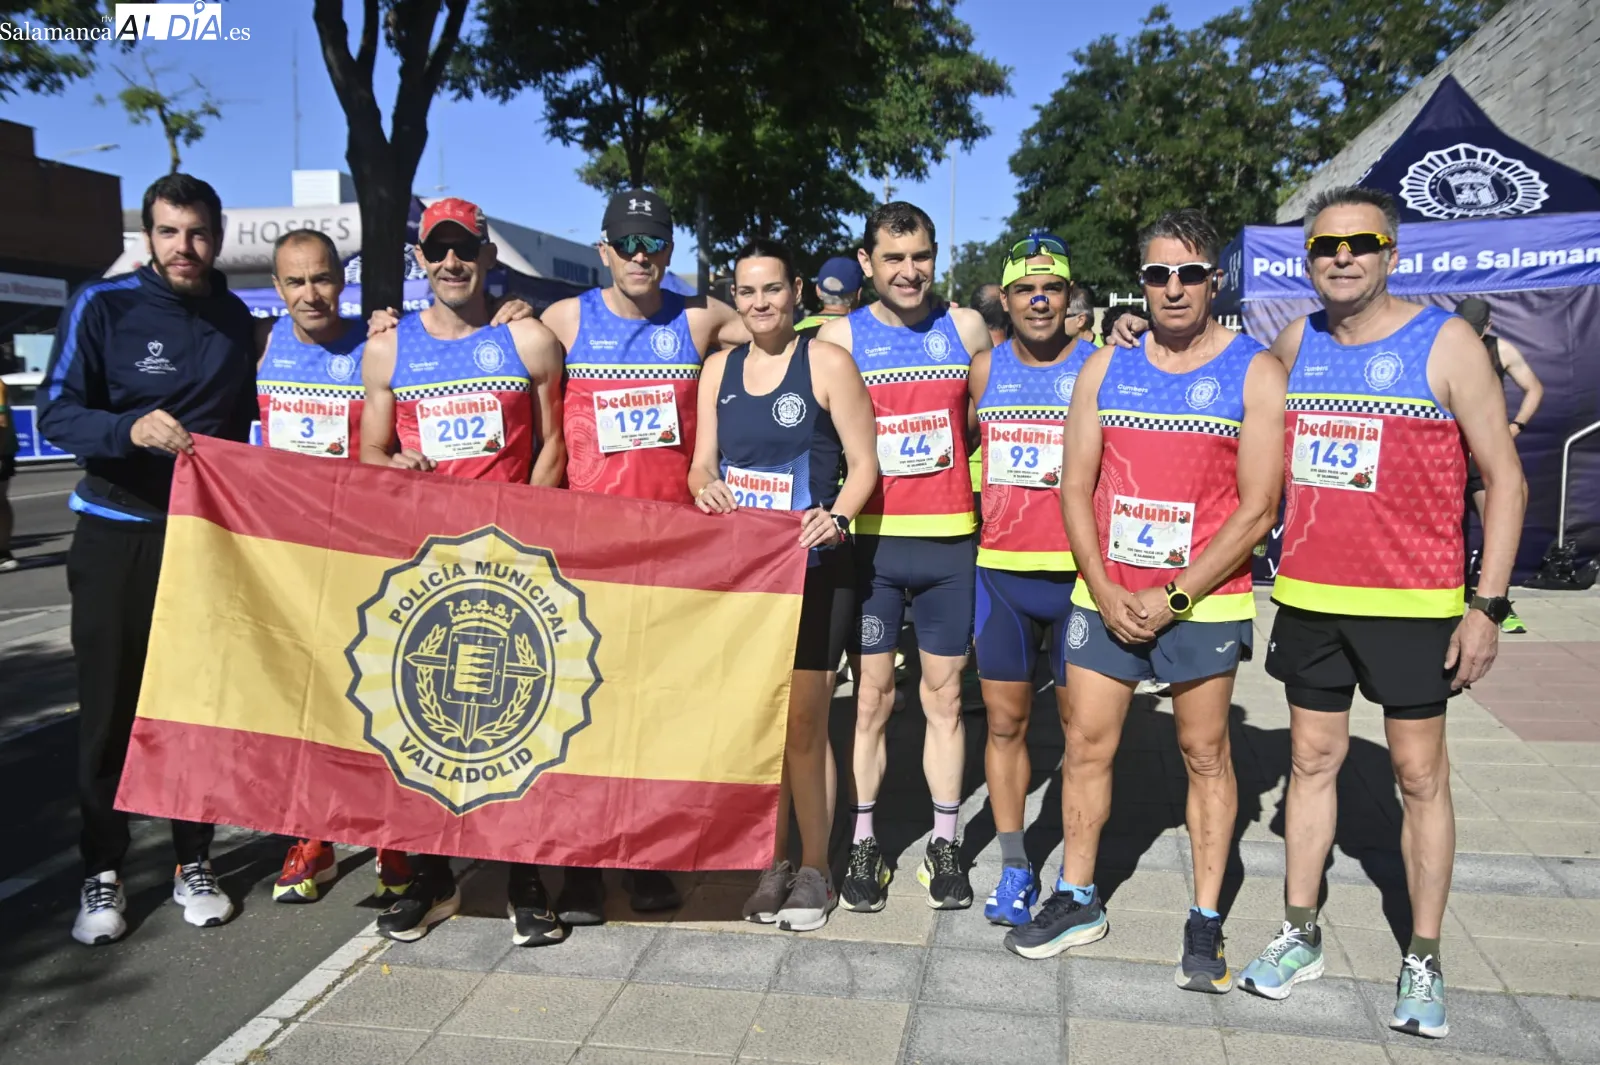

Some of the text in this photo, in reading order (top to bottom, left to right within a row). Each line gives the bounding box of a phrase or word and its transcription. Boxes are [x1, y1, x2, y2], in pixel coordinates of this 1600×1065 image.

[1253, 256, 1305, 277] Poli
[1432, 251, 1468, 272] de
[1476, 246, 1600, 271] Salaman
[270, 397, 346, 417] bedunia
[418, 398, 499, 419] bedunia
[300, 417, 314, 438] 3
[437, 416, 487, 442] 202
[614, 407, 661, 433] 192
[876, 415, 949, 436] bedunia
[1298, 418, 1379, 442] bedunia
[900, 434, 932, 457] 44
[990, 427, 1064, 445] bedunia
[1010, 445, 1039, 469] 93
[1309, 440, 1358, 469] 143
[727, 469, 790, 493] bedunia
[734, 490, 773, 509] 203
[1137, 523, 1154, 548] 4
[388, 561, 568, 643] POLICÍA MUNICIPAL
[398, 735, 533, 783] VALLADOLID
